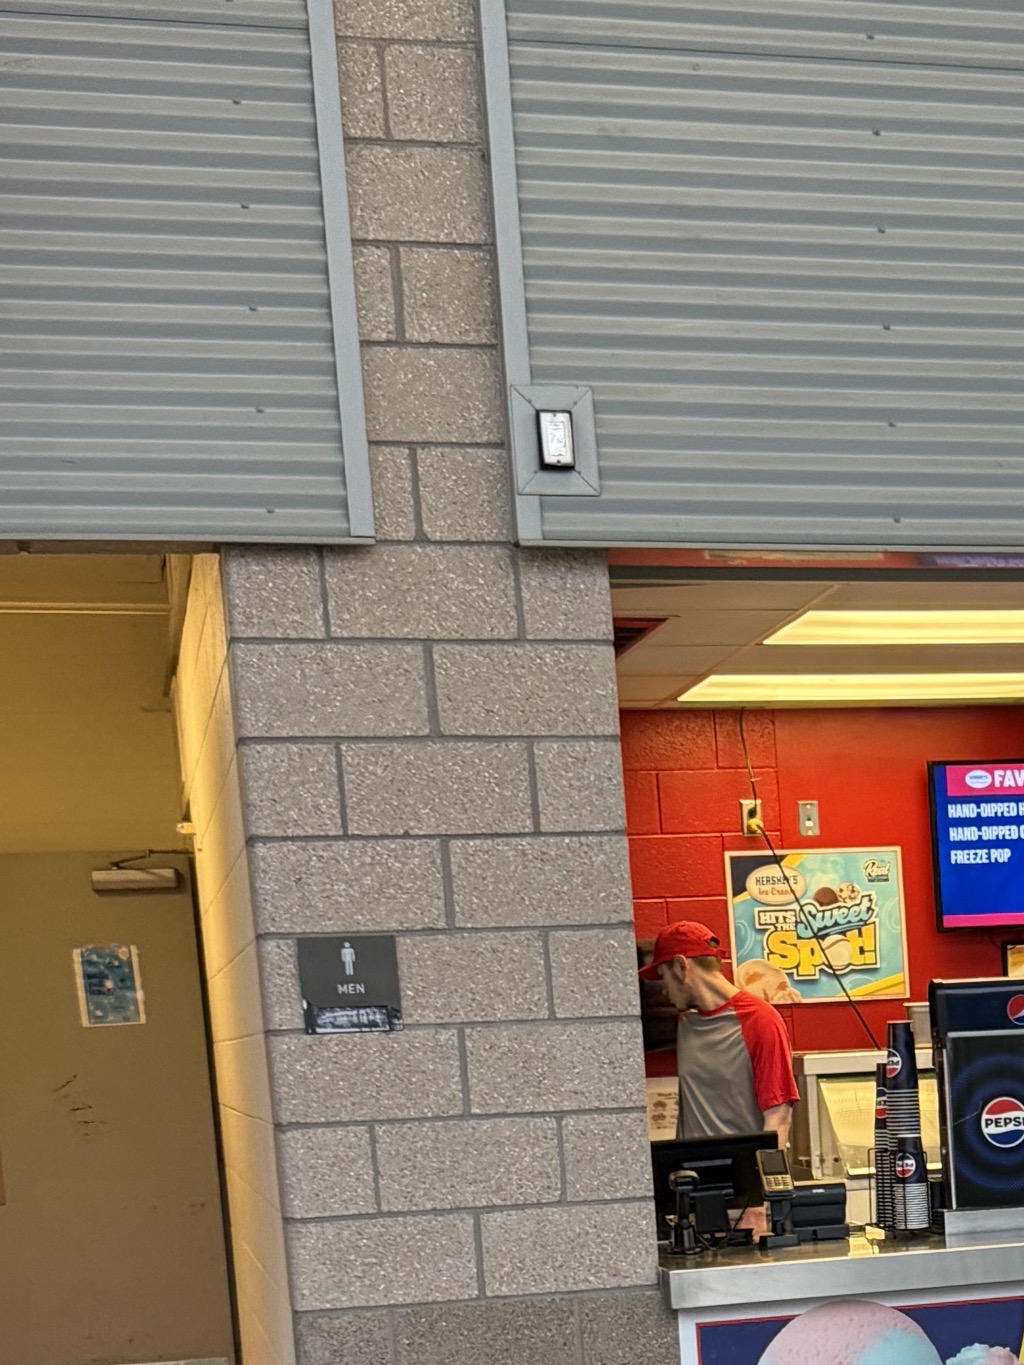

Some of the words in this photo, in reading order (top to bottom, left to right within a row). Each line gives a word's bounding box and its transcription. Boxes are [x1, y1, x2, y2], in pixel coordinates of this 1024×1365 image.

[947, 802, 1017, 819] HAND-DIPPED
[949, 825, 1019, 841] HAND-DIPPED
[950, 848, 989, 864] FREEZE
[990, 848, 1011, 863] POP
[771, 887, 794, 896] Crea
[759, 911, 796, 924] HITS
[796, 895, 875, 938] Sweet
[775, 923, 796, 931] THE
[337, 983, 365, 994] MEN
